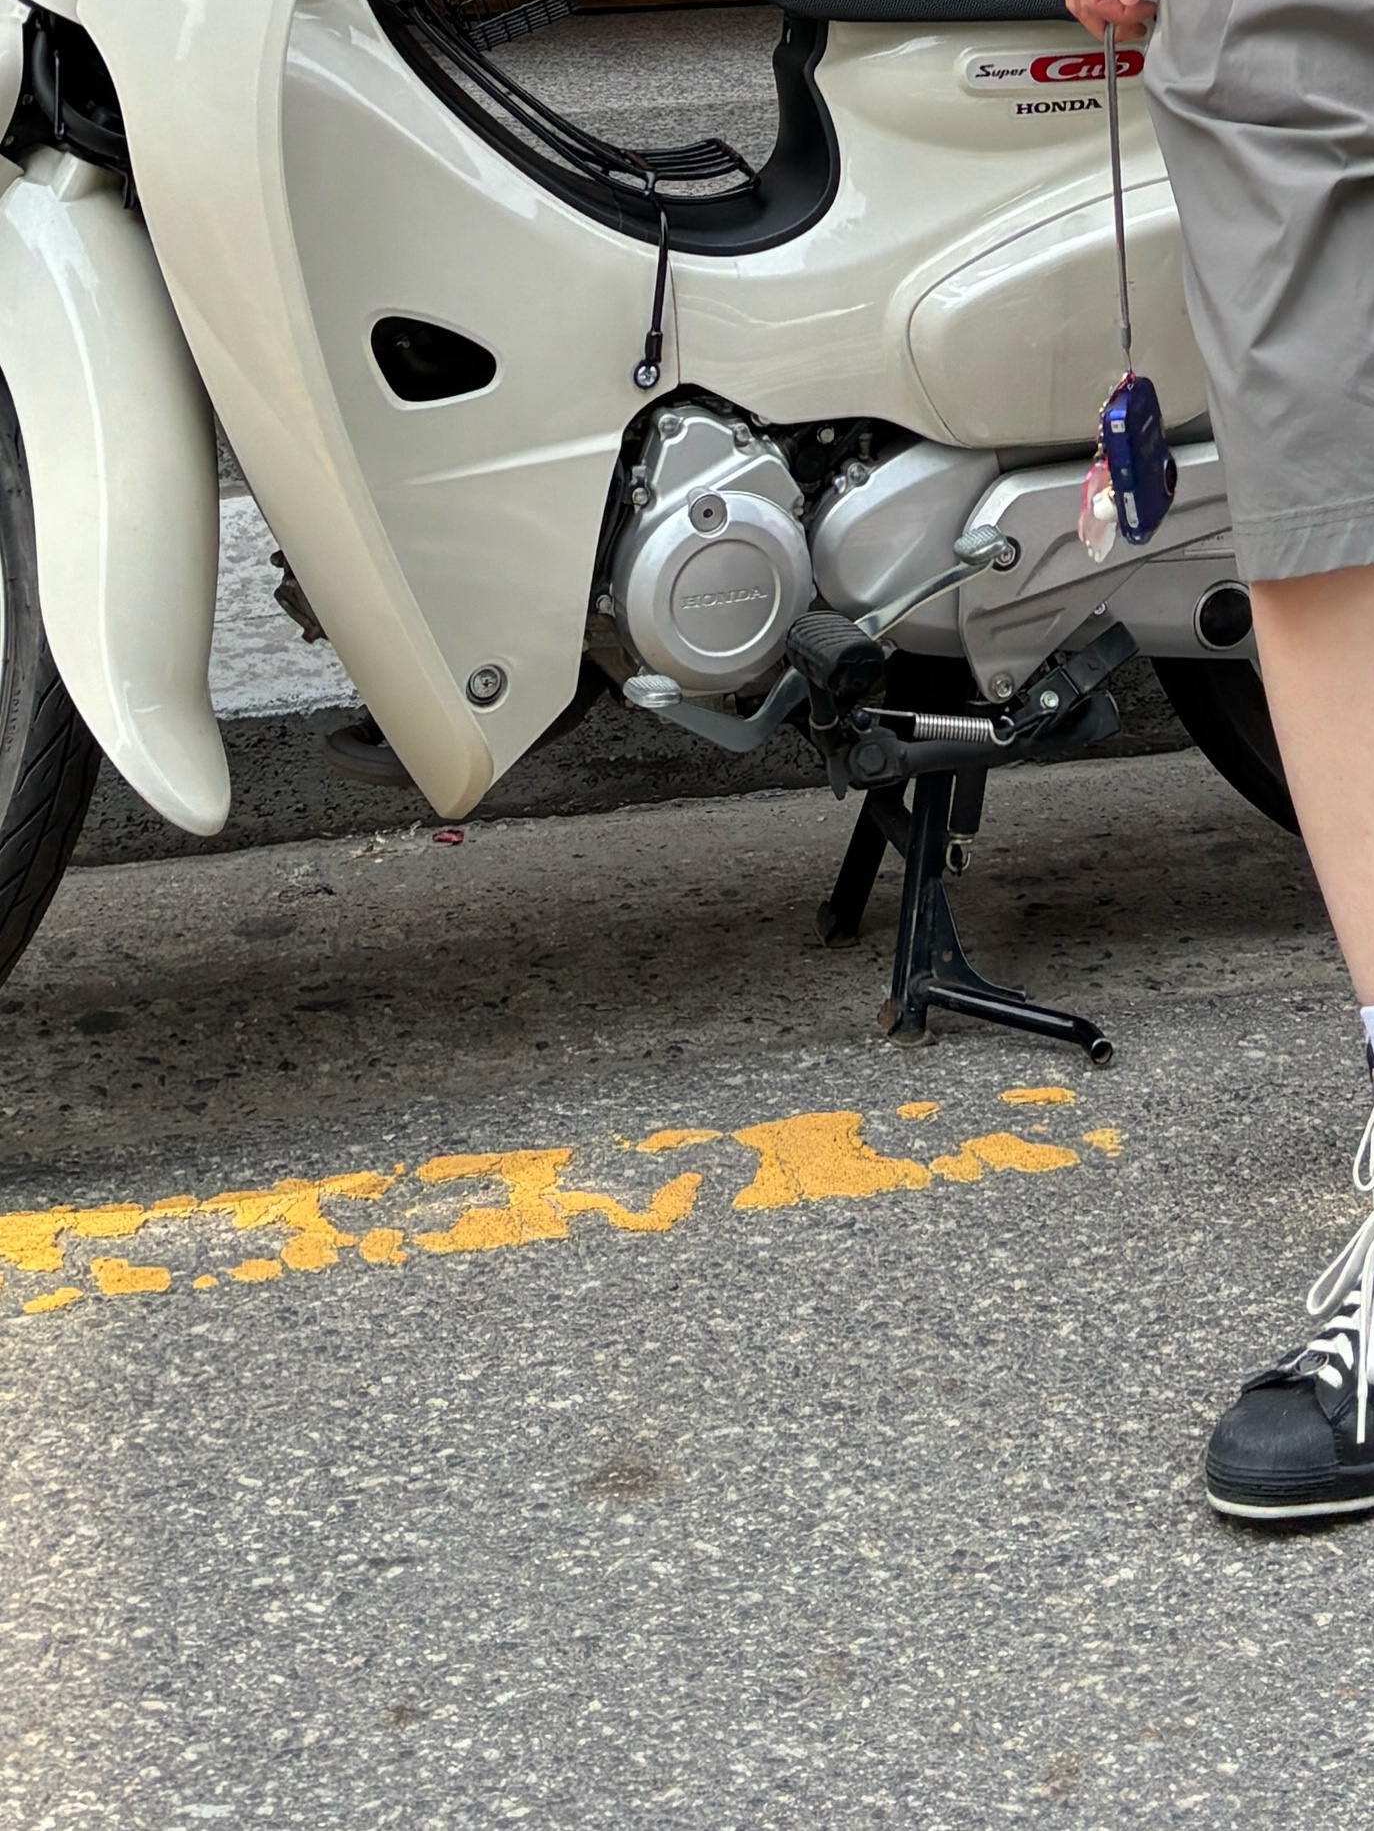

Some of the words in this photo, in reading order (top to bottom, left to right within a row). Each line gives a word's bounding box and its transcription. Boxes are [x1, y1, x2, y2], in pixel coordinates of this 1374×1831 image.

[975, 64, 1027, 80] Super
[1015, 98, 1103, 115] HONDA
[681, 587, 768, 610] HONDA
